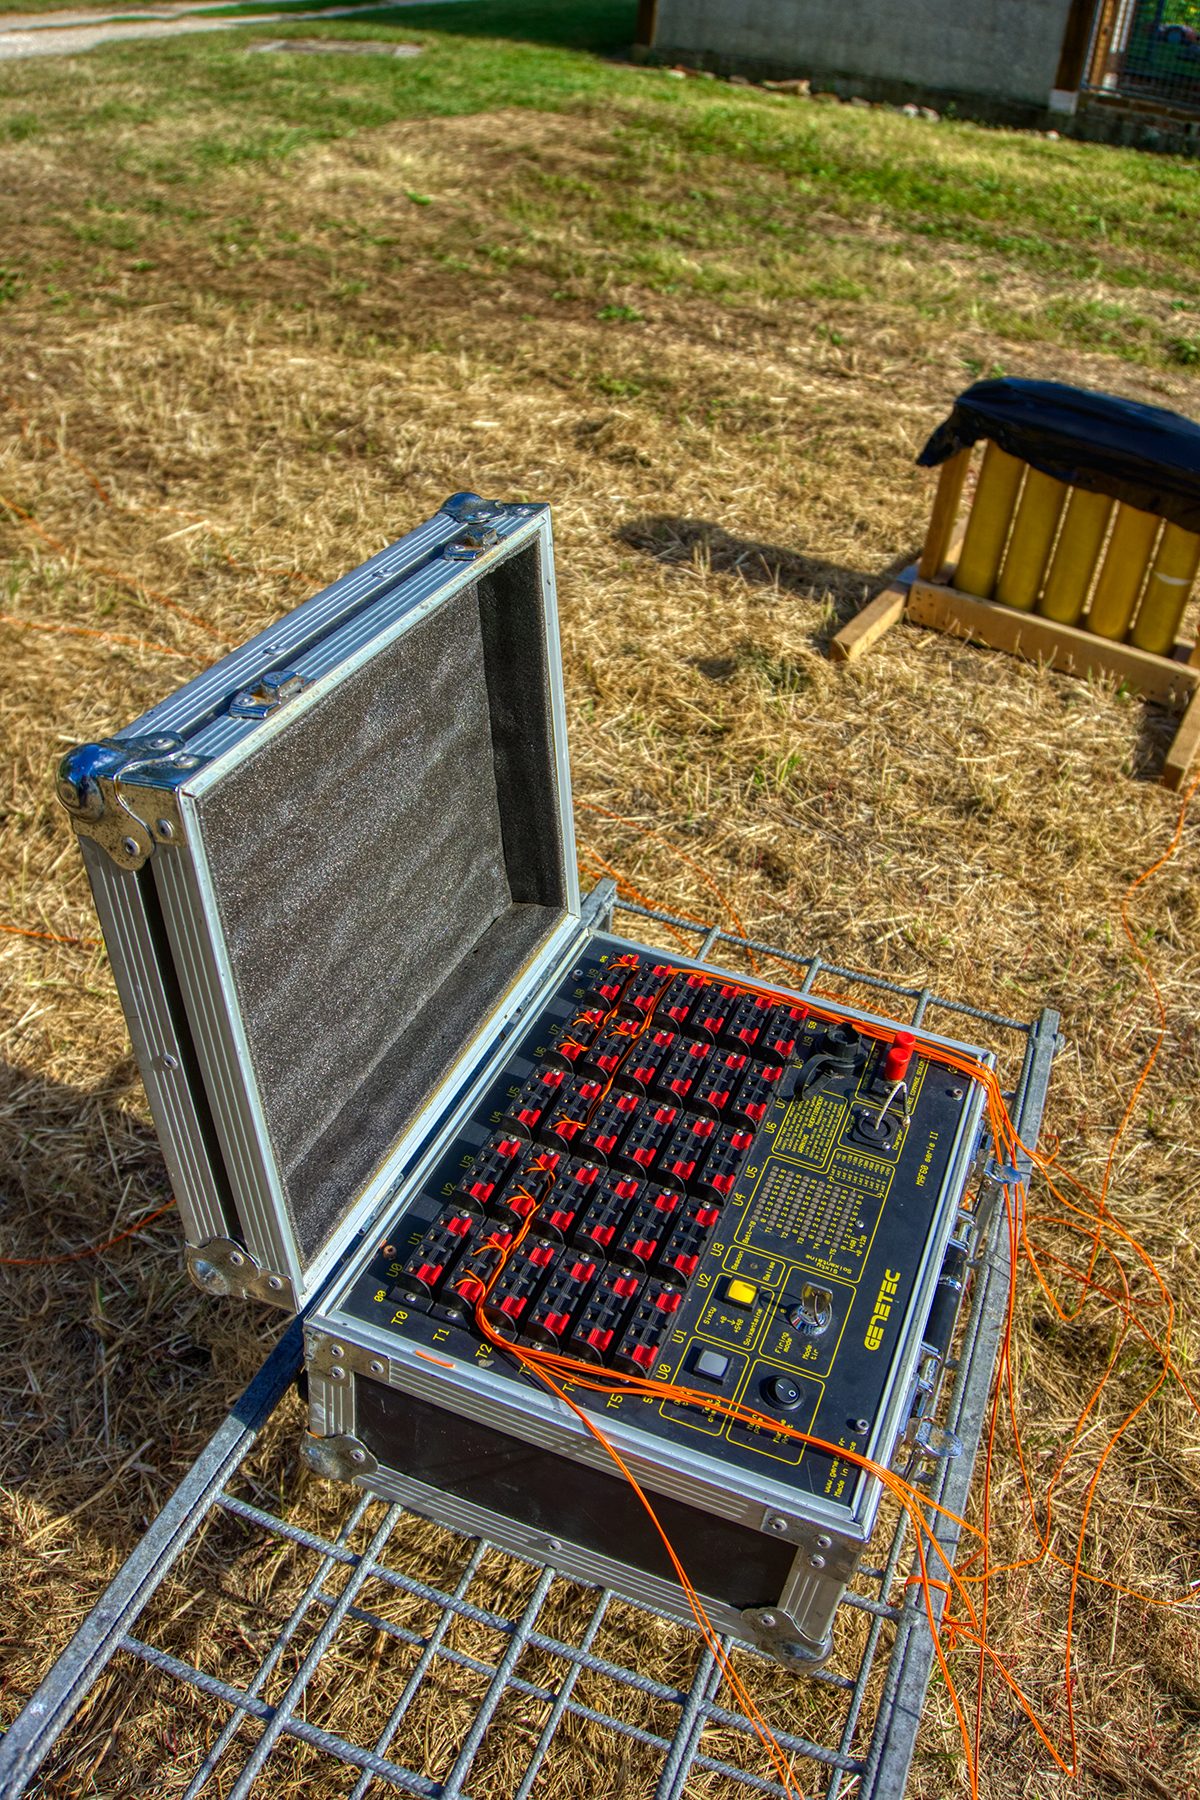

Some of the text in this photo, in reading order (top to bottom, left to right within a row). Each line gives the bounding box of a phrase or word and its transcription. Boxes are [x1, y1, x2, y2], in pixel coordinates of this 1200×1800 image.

[548, 1024, 561, 1035] U7
[533, 1046, 546, 1058] U6
[506, 1085, 520, 1098] U5
[775, 1097, 788, 1109] U7
[489, 1111, 503, 1124] U4
[764, 1121, 777, 1135] U6
[459, 1155, 474, 1168] U3
[745, 1165, 759, 1179] U5
[915, 1164, 929, 1187] MAF60
[441, 1183, 456, 1197] U2
[732, 1192, 746, 1207] U4
[408, 1232, 423, 1246] U1
[780, 1231, 789, 1239] T2
[710, 1242, 725, 1257] U3
[829, 1248, 837, 1256] T5
[731, 1250, 744, 1271] Beacon
[805, 1254, 852, 1274] Soixantaine
[816, 1262, 838, 1274] Sixty
[762, 1261, 776, 1281] Balise
[696, 1273, 711, 1288] U2
[703, 1306, 717, 1325] Sixty
[864, 1269, 901, 1350] GENETEC
[391, 1310, 408, 1325] T0
[743, 1308, 763, 1346] Soixantaine
[432, 1329, 450, 1343] T1
[672, 1329, 687, 1344] U1
[774, 1331, 789, 1354] Firing
[475, 1343, 493, 1360] T2
[784, 1337, 792, 1353] mode
[802, 1344, 812, 1360] Mode
[810, 1349, 819, 1360] tir
[655, 1363, 671, 1380] U0
[606, 1393, 624, 1409] T5
[833, 1480, 846, 1498] Made
[840, 1468, 849, 1477] in
